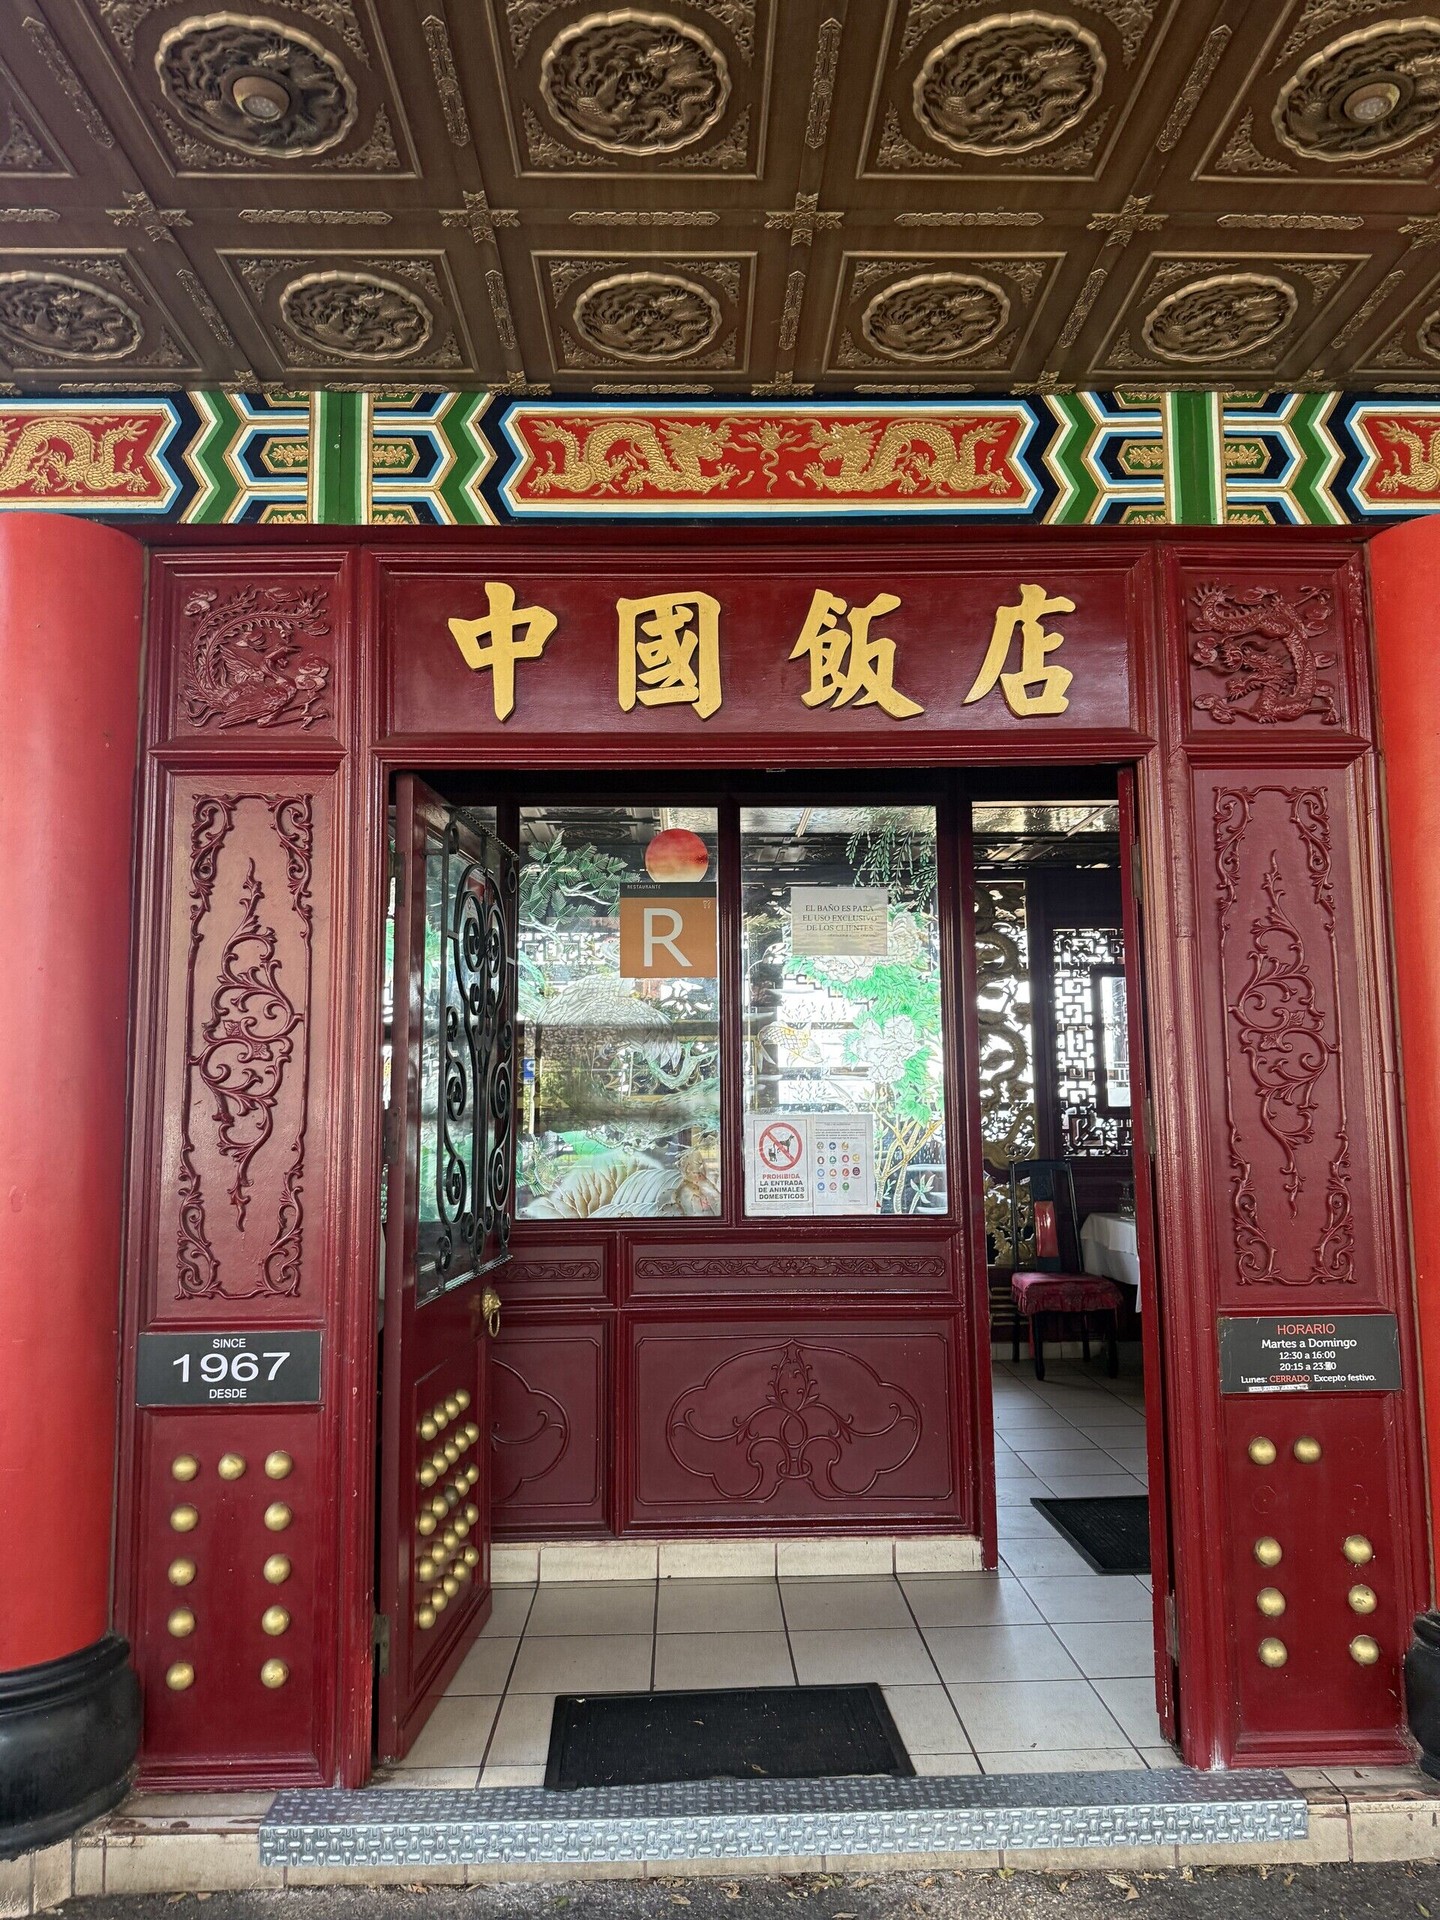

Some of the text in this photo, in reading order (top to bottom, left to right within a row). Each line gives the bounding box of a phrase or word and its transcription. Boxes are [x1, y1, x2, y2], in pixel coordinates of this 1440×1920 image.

[447, 581, 1077, 722] 中國飯店
[805, 904, 815, 912] EL
[818, 903, 840, 912] BAÑO
[841, 904, 851, 912] ES
[802, 914, 878, 922] EL USO EXCLUSIVO
[643, 907, 693, 967] R
[1277, 1323, 1336, 1335] HORARIO
[212, 1338, 246, 1349] SINCE
[1261, 1339, 1297, 1349] Martes
[1308, 1337, 1357, 1350] Domingo
[1279, 1351, 1303, 1360] 12:30
[1312, 1350, 1336, 1360] 16:00
[172, 1352, 291, 1383] 1967
[1279, 1362, 1304, 1371] 20:15
[1312, 1361, 1337, 1371] 23:0
[1240, 1373, 1377, 1384] Lunes: CERRADO. Excepto festivo.
[209, 1388, 247, 1399] DESDE
